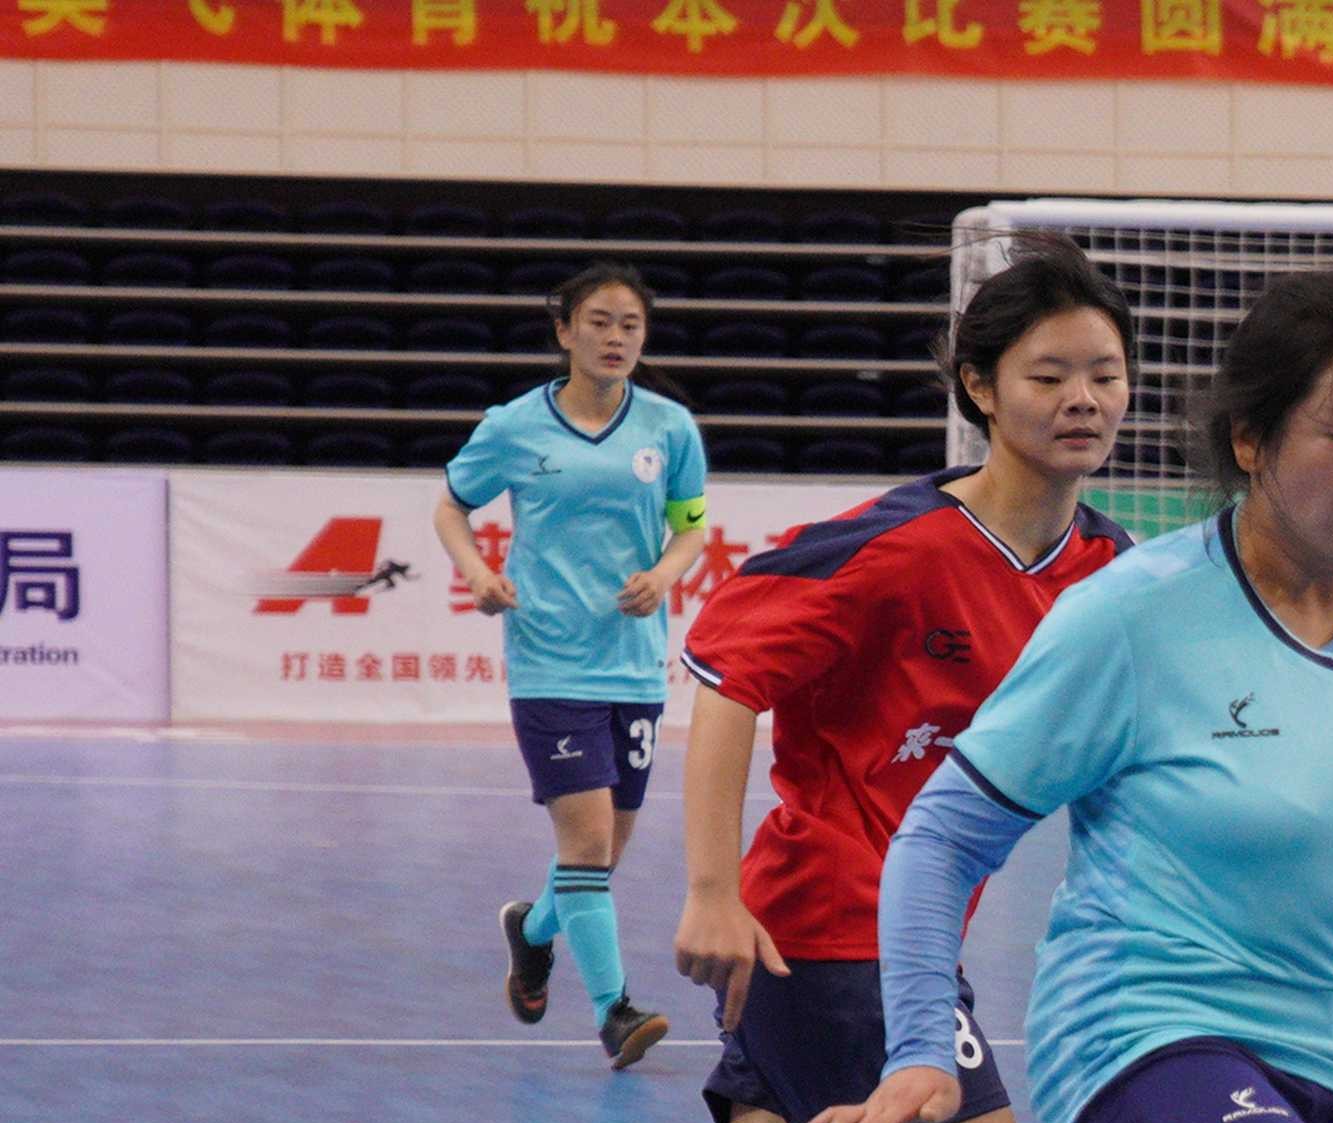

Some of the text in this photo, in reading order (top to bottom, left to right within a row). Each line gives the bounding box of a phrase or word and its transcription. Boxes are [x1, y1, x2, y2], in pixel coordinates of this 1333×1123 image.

[0, 531, 79, 620] 局
[0, 643, 78, 664] ration
[281, 652, 507, 683] 打造全国领先
